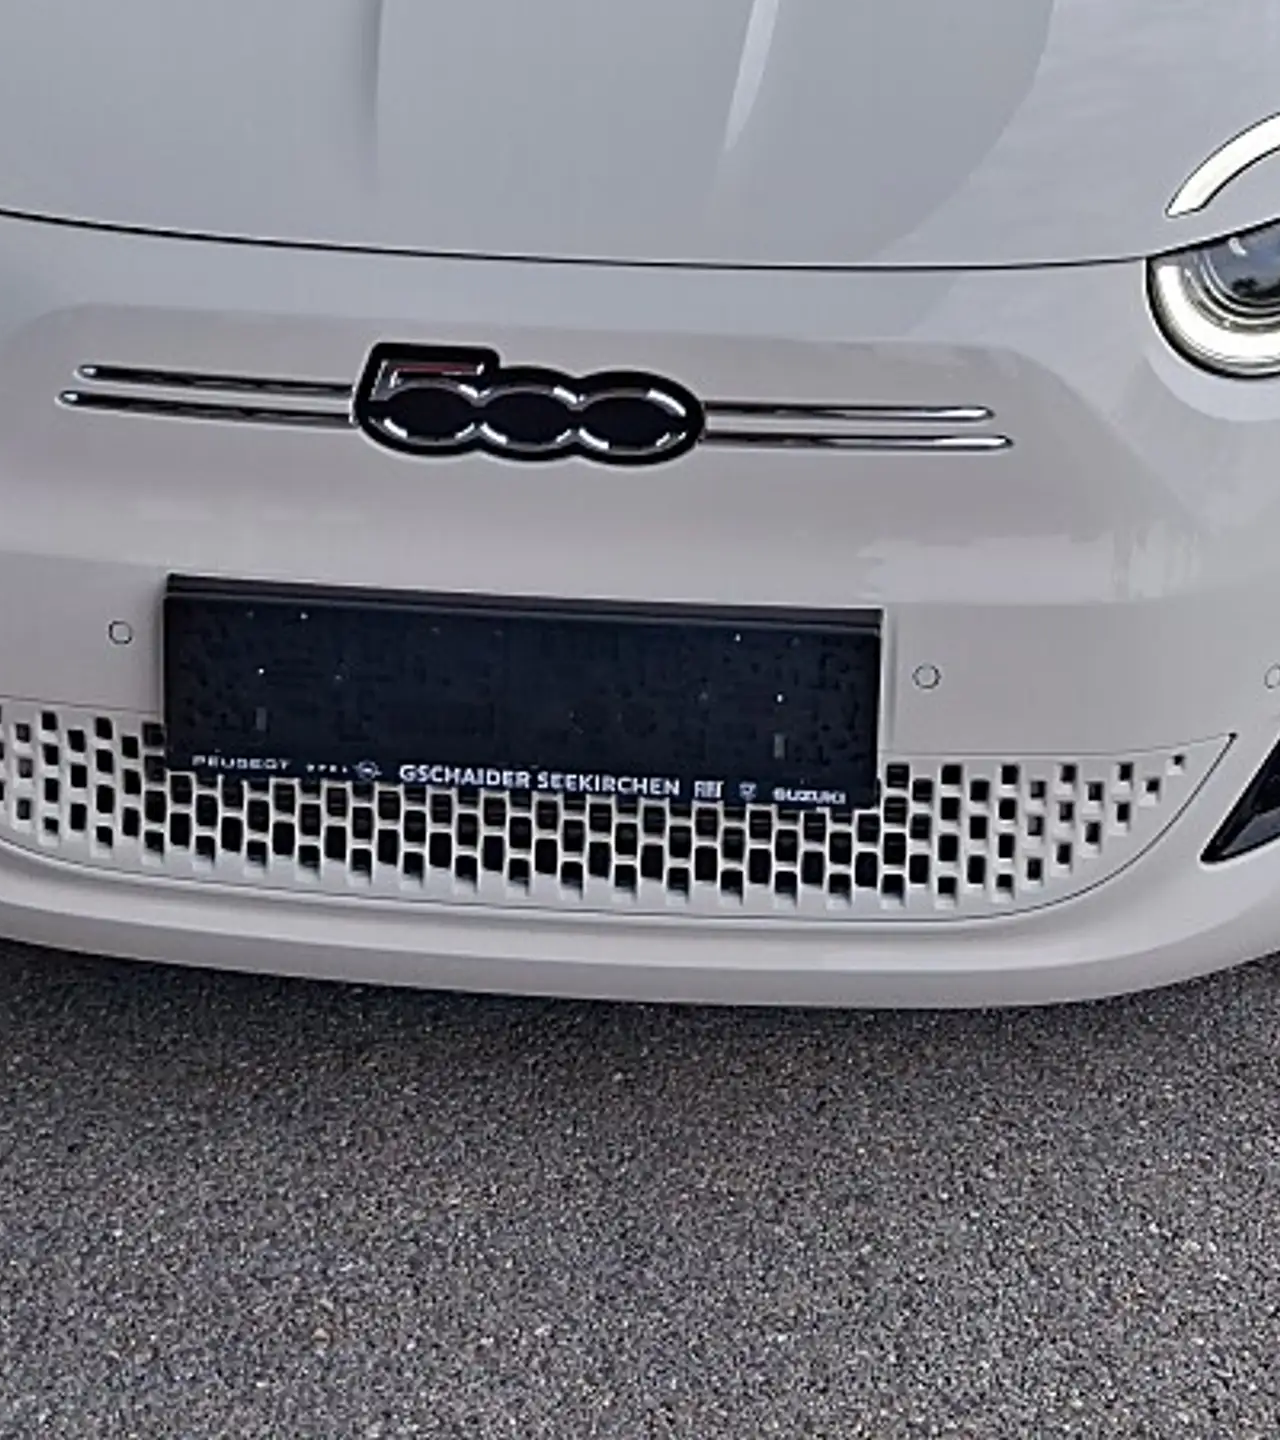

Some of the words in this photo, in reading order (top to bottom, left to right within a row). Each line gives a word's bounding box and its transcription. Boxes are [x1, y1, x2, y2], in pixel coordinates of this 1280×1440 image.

[355, 338, 704, 465] 500
[399, 764, 530, 789] GSCHAIDER
[537, 771, 680, 796] SEEKIRCHEN
